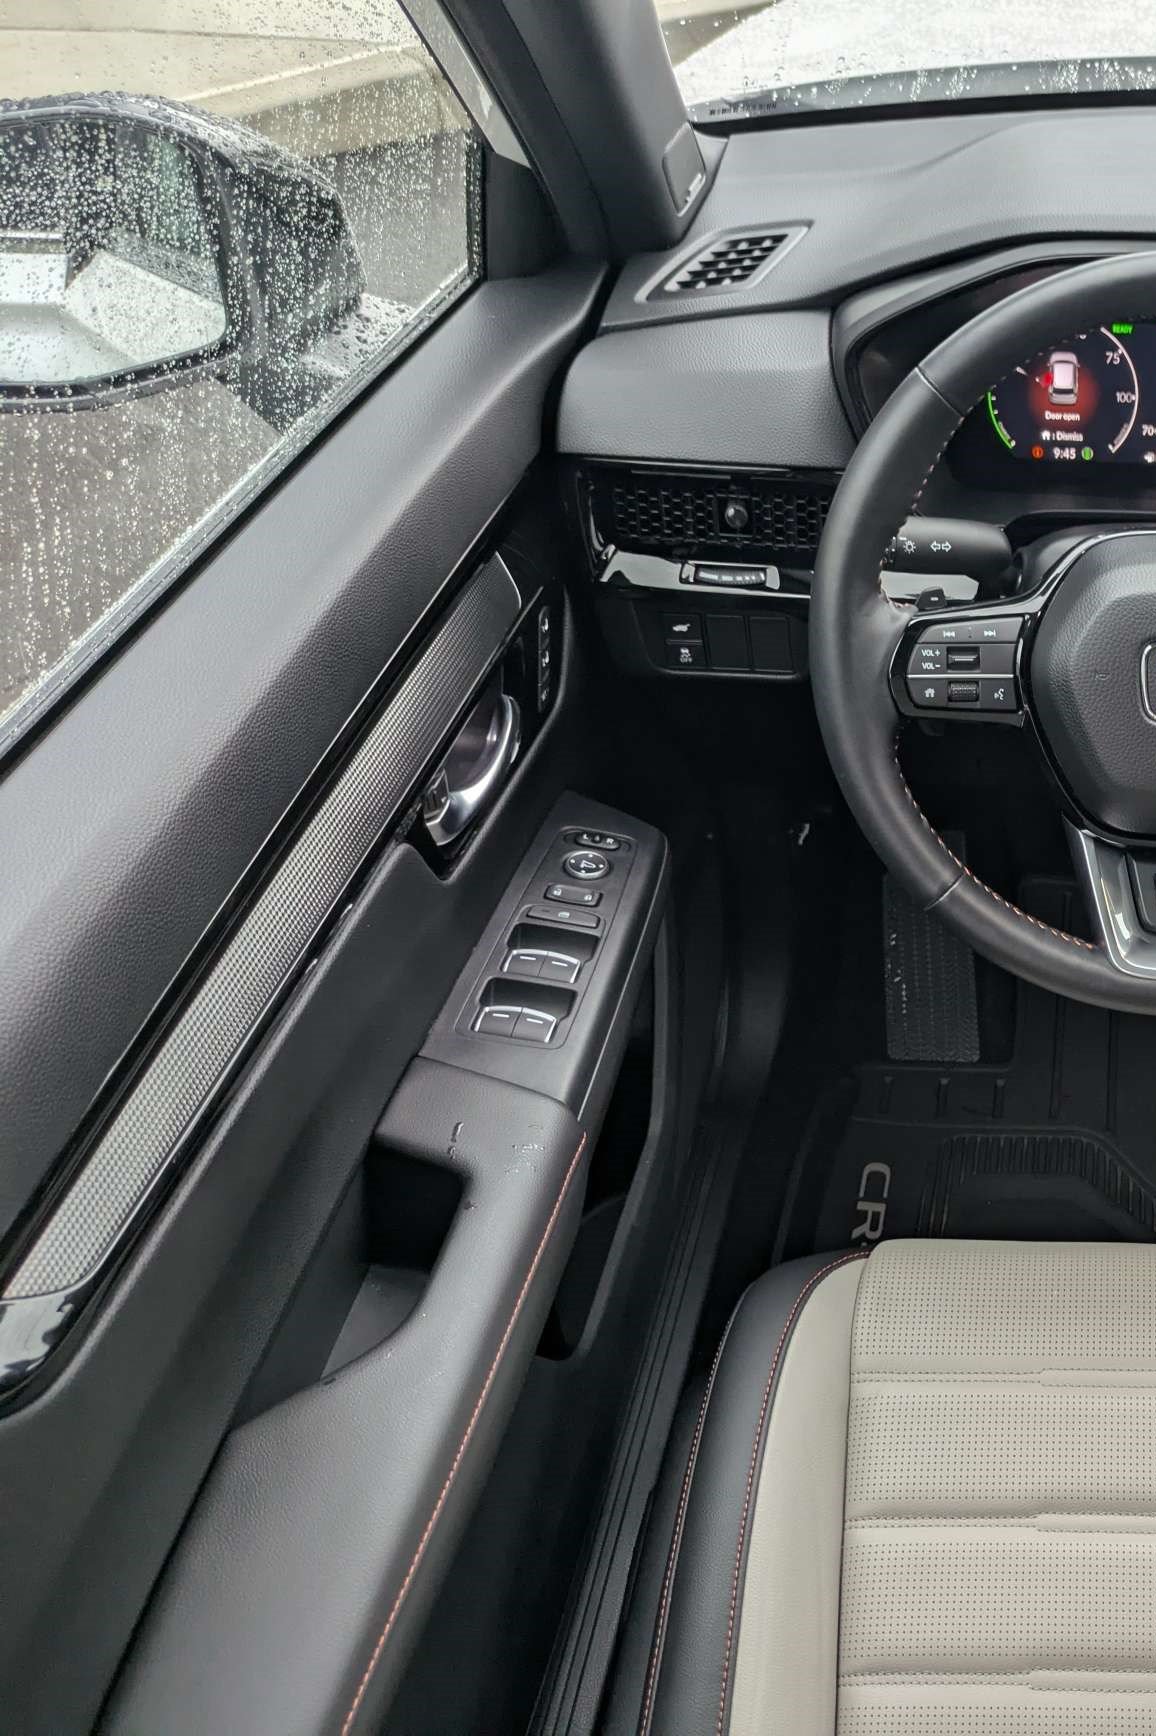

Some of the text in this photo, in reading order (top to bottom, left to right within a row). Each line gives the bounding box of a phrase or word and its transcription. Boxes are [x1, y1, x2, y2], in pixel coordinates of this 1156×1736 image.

[1112, 324, 1133, 334] READY
[1105, 352, 1121, 365] 75
[1116, 391, 1133, 403] 100
[1044, 410, 1081, 422] Door open
[1056, 431, 1084, 442] Dismiss
[1053, 447, 1077, 460] 9:45
